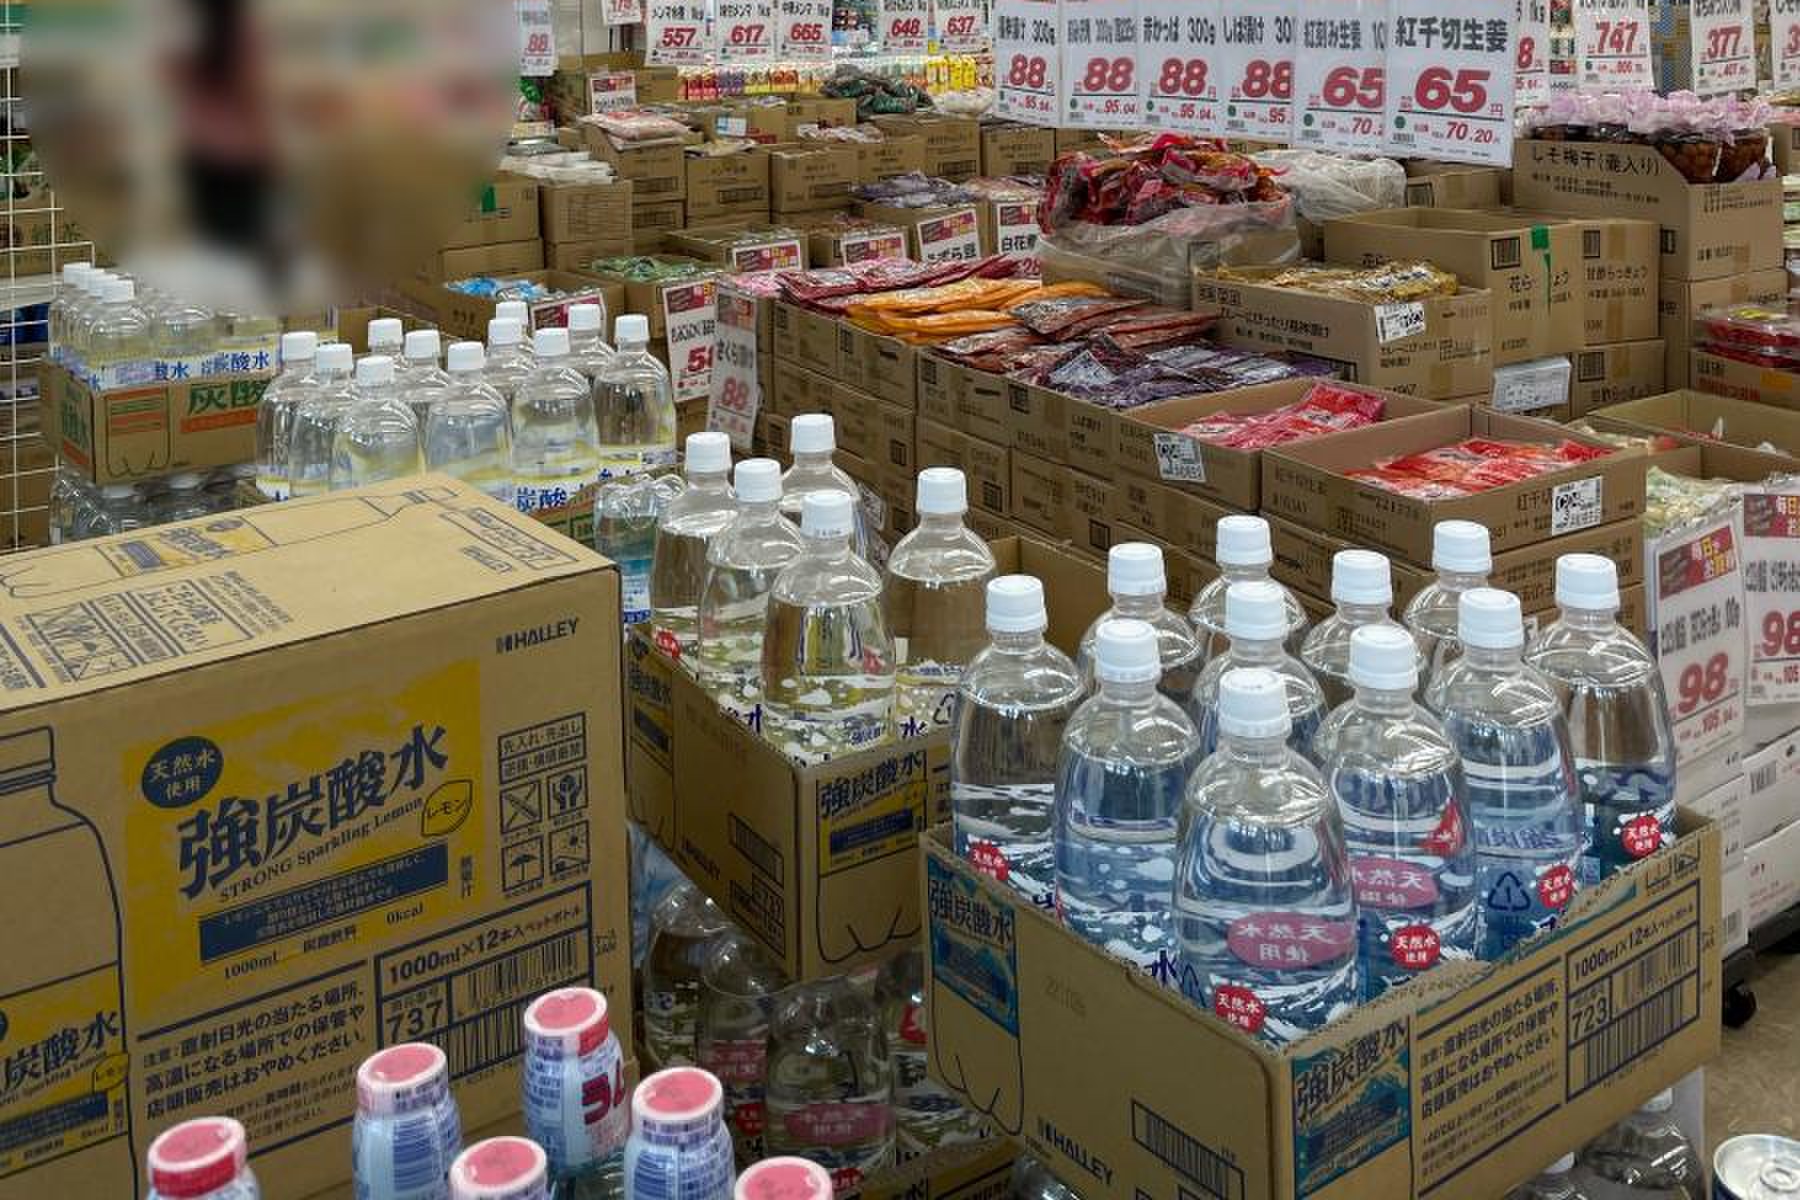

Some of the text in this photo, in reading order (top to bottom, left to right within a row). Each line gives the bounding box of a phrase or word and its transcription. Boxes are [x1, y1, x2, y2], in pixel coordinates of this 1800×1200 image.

[662, 27, 697, 48] 557
[731, 24, 765, 44] 617
[789, 22, 823, 41] 665
[890, 17, 922, 37] 648
[946, 15, 975, 34] 637
[1275, 15, 1296, 45] 30
[1395, 15, 1509, 52] 紅千切生姜
[1595, 20, 1638, 53] 747
[1707, 24, 1742, 59] 377
[1008, 53, 1048, 89] 88
[1083, 56, 1134, 92] 88
[1159, 57, 1209, 95] 88
[1241, 59, 1291, 100] 88
[1323, 66, 1384, 110] 65
[1414, 66, 1491, 113] 65
[1446, 121, 1493, 145] 70.20
[515, 617, 579, 650] HALLEY
[1761, 610, 1800, 657] 98
[1677, 652, 1729, 715] 98
[149, 749, 217, 781] 天然水
[164, 778, 201, 800] 使用
[819, 750, 923, 820] 強炭酸水
[177, 722, 449, 901] 強炭酸水
[219, 859, 293, 903] STRONG
[297, 823, 370, 866] Sparkling
[374, 797, 424, 831] Lemon
[386, 902, 424, 925] 0kcal
[1396, 932, 1438, 952] 天然水
[224, 950, 280, 980] 1000ml
[1216, 992, 1261, 1014] 天然水
[1571, 997, 1608, 1041] 723
[385, 999, 444, 1044] 737
[1295, 1021, 1409, 1124] 強炭酸水
